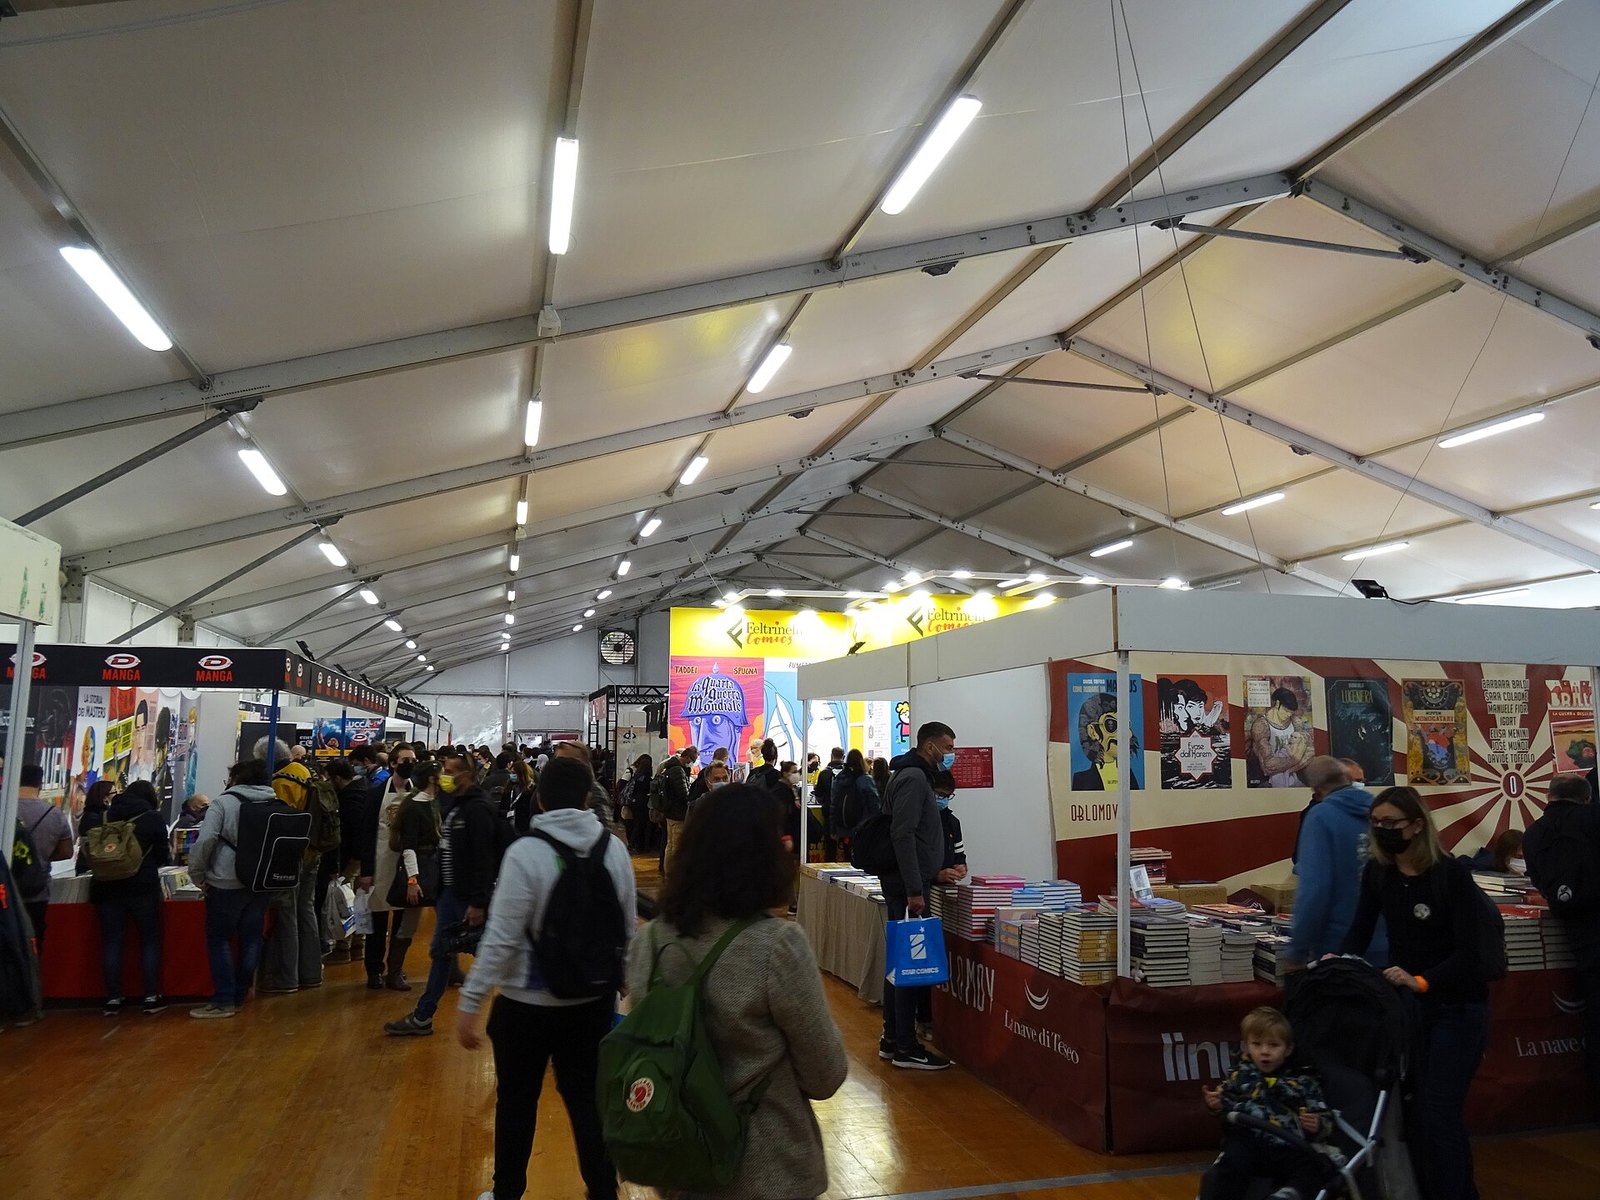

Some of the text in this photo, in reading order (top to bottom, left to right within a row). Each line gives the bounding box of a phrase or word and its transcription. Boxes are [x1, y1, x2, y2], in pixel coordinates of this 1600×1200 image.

[746, 632, 793, 646] Comics
[102, 669, 141, 681] MANGA
[675, 666, 699, 674] TADDEI
[733, 667, 758, 675] SPUGNA
[195, 670, 233, 682] MANGA
[1482, 679, 1530, 690] BARBARA BALDI
[90, 693, 103, 704] STORIA
[1484, 691, 1502, 702] SARA
[1487, 703, 1529, 714] MANUELE FIOR
[1499, 716, 1517, 727] IGORT
[1490, 728, 1529, 739] ELISA MENINI
[1487, 753, 1535, 764] DAVIDE TOFFOLO
[1070, 804, 1119, 822] OBLOMOV
[1013, 1021, 1037, 1043] nave
[1038, 1026, 1050, 1048] di
[1050, 1030, 1080, 1065] Teseo
[1514, 1036, 1539, 1057] La
[1540, 1037, 1578, 1056] nave
